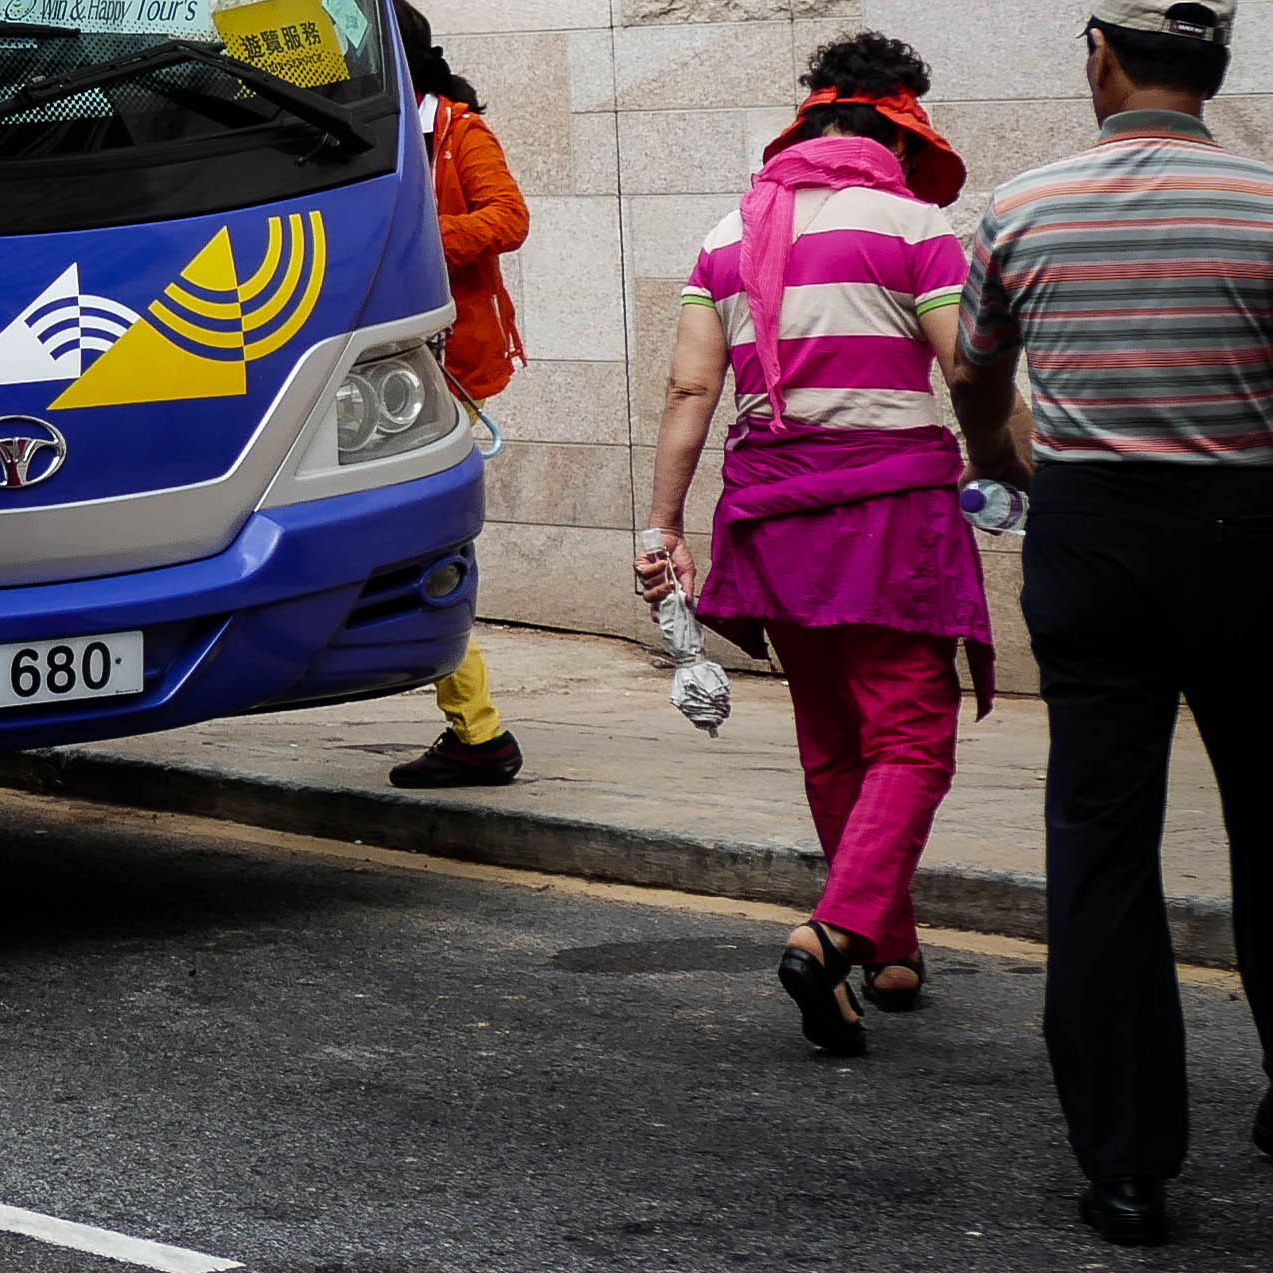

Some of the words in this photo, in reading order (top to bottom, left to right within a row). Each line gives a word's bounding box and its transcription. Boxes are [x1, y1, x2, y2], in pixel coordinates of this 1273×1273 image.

[238, 20, 322, 59] 遊覽服務
[10, 641, 112, 698] 680
